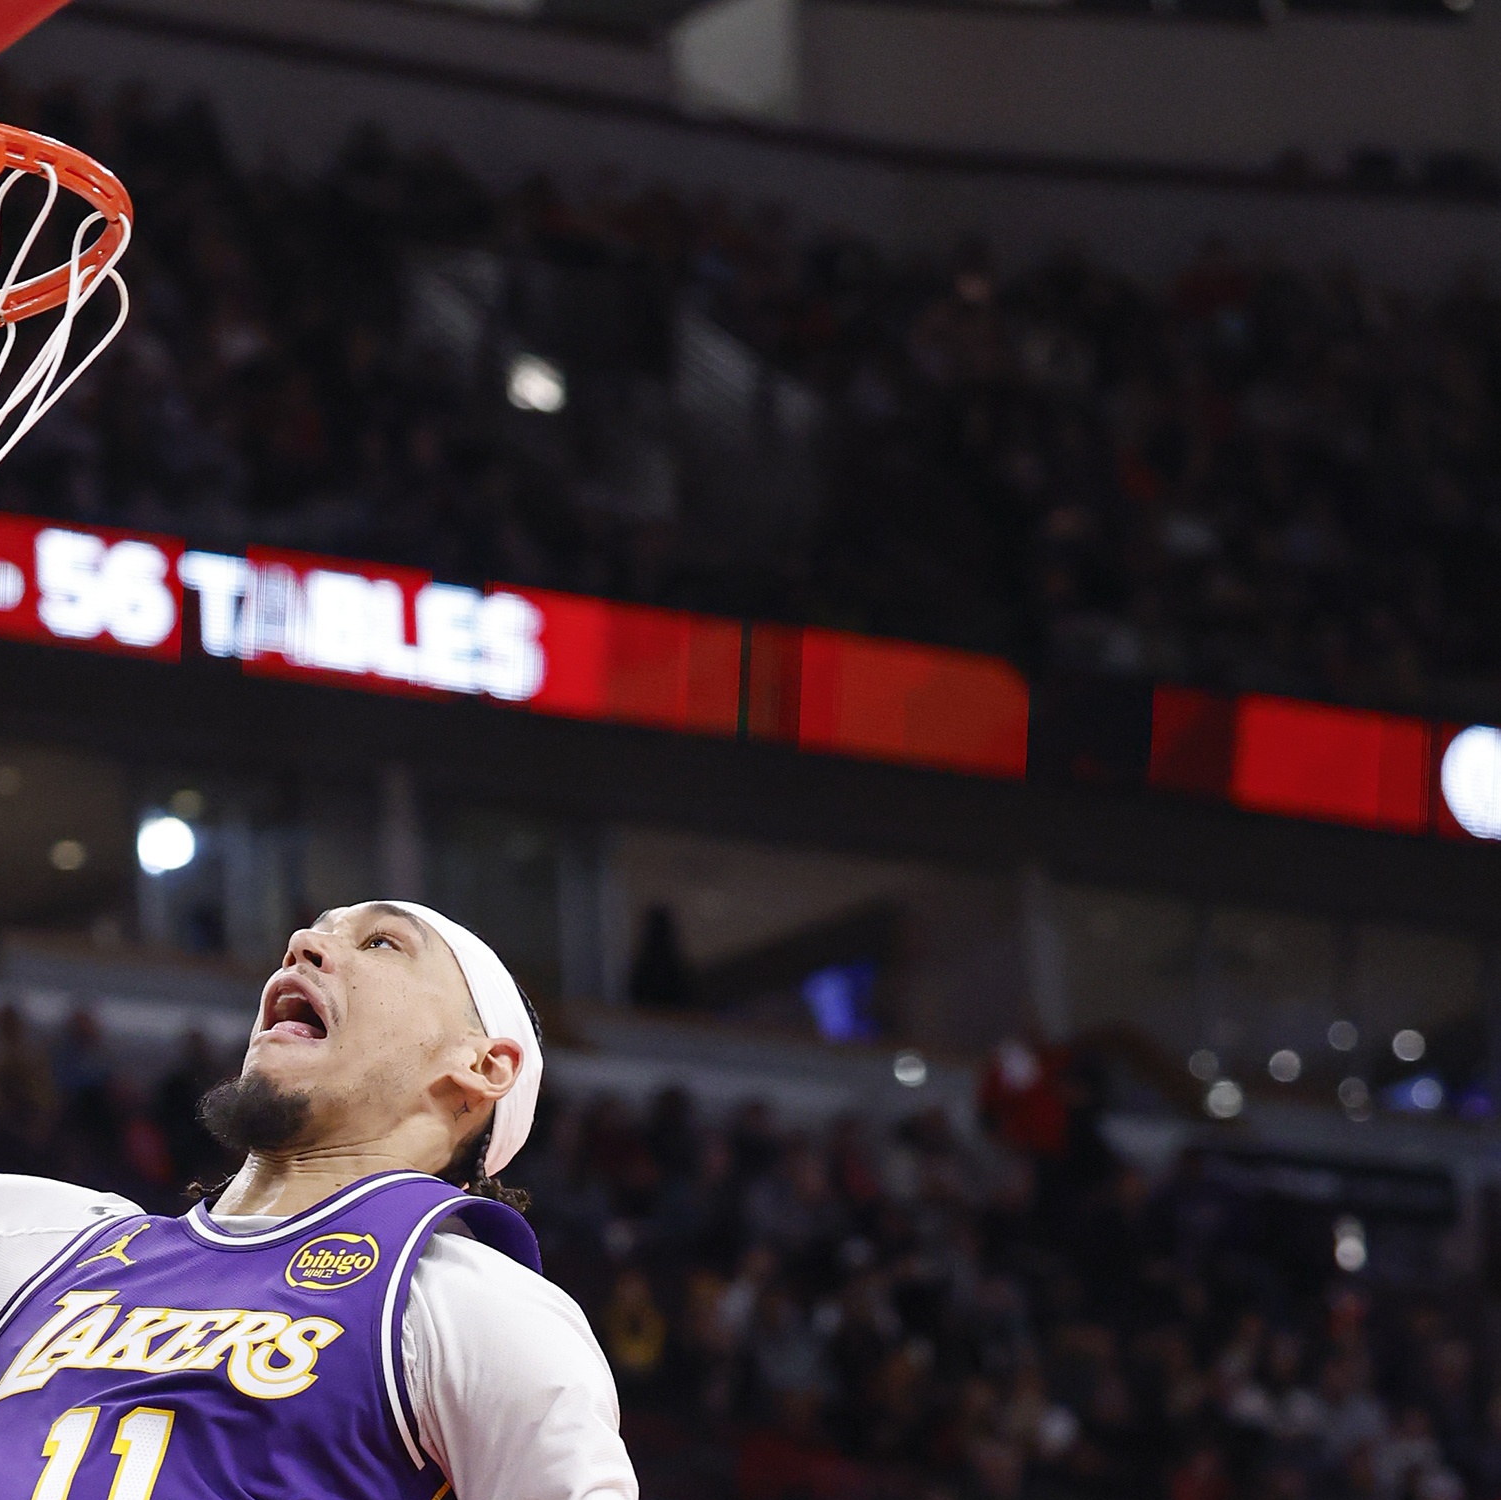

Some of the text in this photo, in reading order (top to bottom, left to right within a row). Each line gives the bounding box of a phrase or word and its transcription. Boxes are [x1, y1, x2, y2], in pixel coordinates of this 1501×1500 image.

[35, 526, 177, 648] 56
[178, 549, 547, 702] TABLES
[296, 1247, 372, 1275] bibigo
[302, 1268, 335, 1279] 비비고
